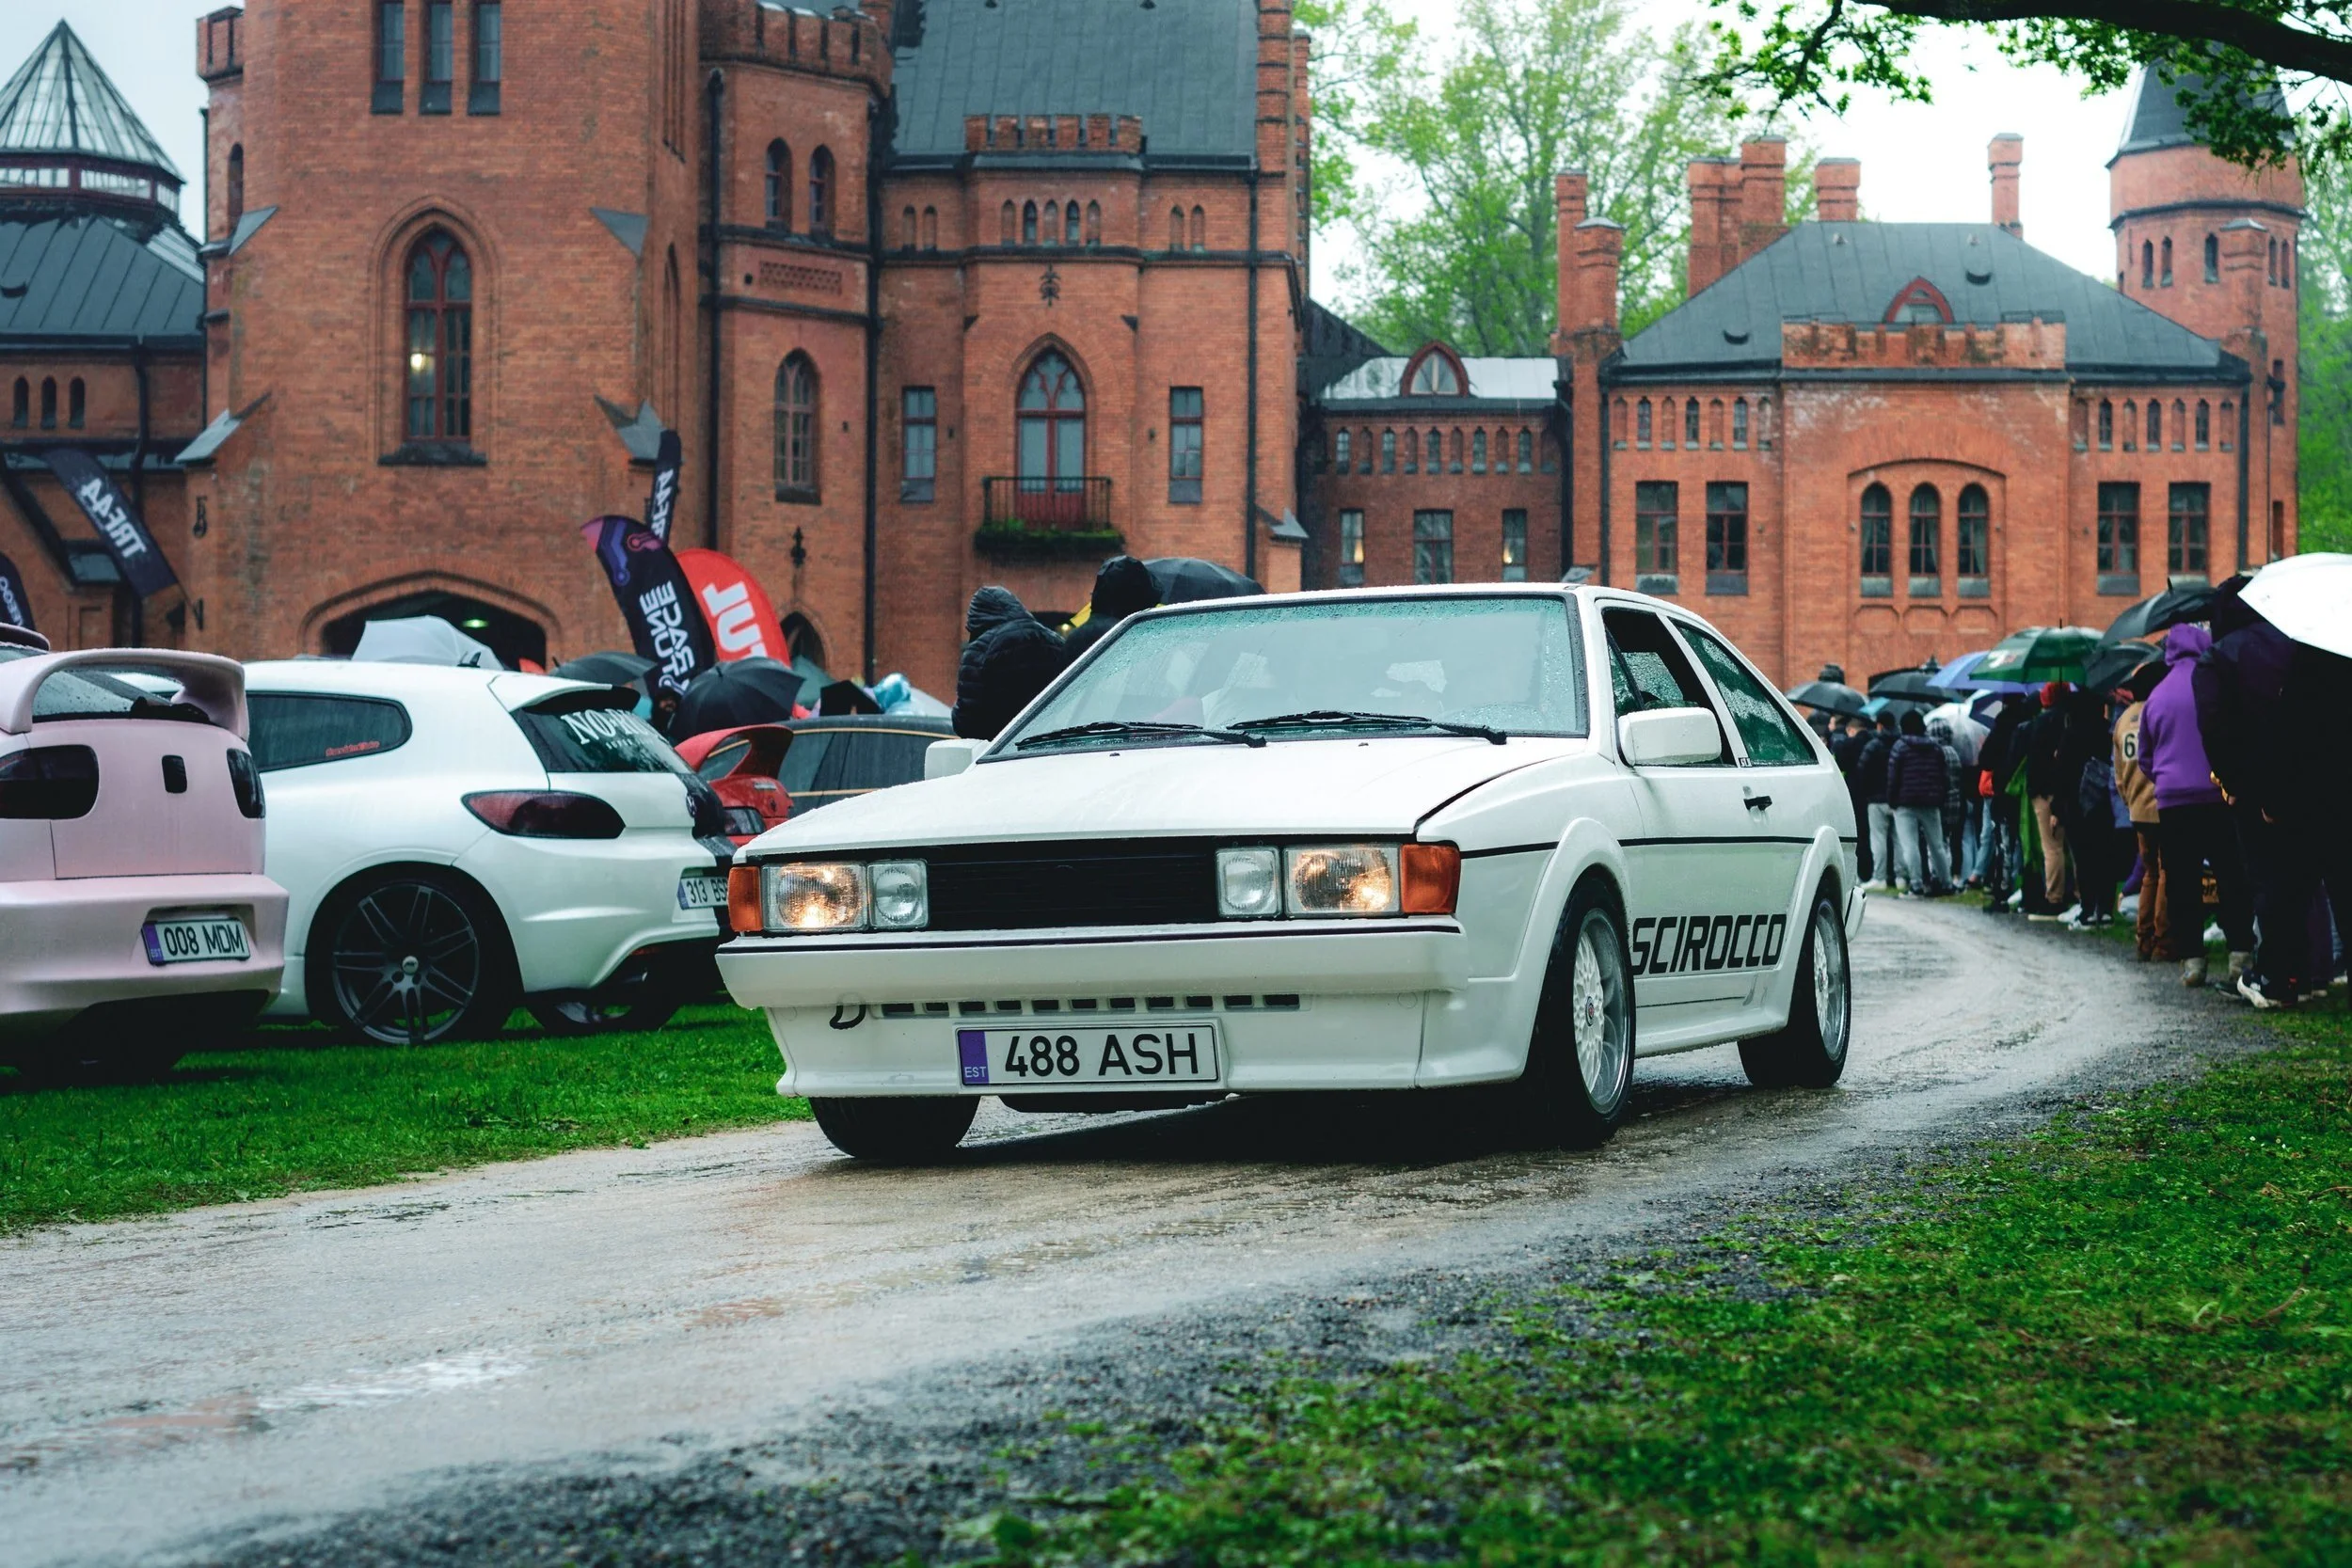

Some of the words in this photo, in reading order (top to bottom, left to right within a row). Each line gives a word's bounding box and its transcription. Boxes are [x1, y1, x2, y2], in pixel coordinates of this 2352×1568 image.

[686, 879, 707, 904] 313
[164, 927, 199, 956] 008
[201, 924, 245, 955] MDM
[1629, 913, 1787, 975] SCIROCCO
[1005, 1036, 1080, 1077] 488
[1098, 1033, 1199, 1076] ASH
[964, 1065, 987, 1078] EST
